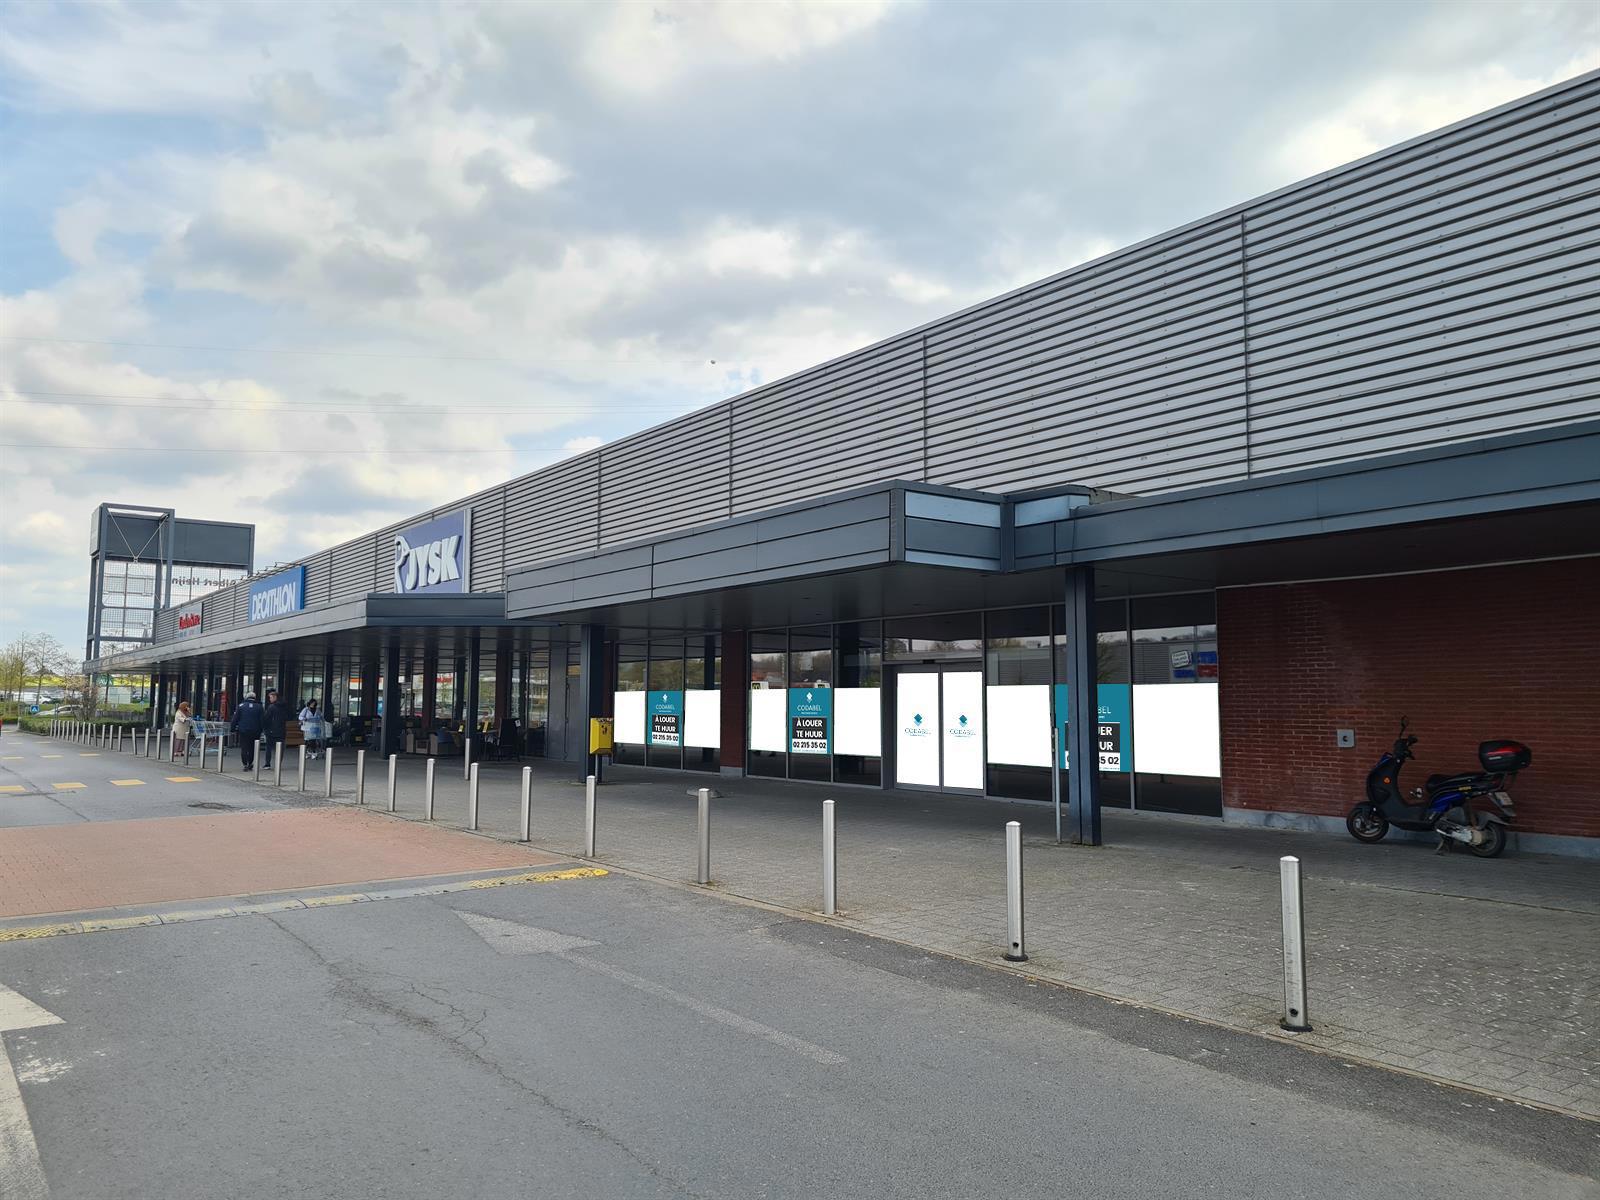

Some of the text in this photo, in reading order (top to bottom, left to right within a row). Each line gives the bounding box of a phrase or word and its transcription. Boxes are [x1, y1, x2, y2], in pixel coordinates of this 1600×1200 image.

[405, 534, 460, 590] JYSK
[252, 581, 296, 621] DECATHLON
[797, 704, 822, 712] CODABEL
[796, 716, 823, 727] À LOUER
[796, 730, 804, 738] TE
[800, 741, 810, 749] 215
[810, 741, 819, 749] 35
[1098, 741, 1114, 751] UR
[1107, 756, 1120, 765] 02
